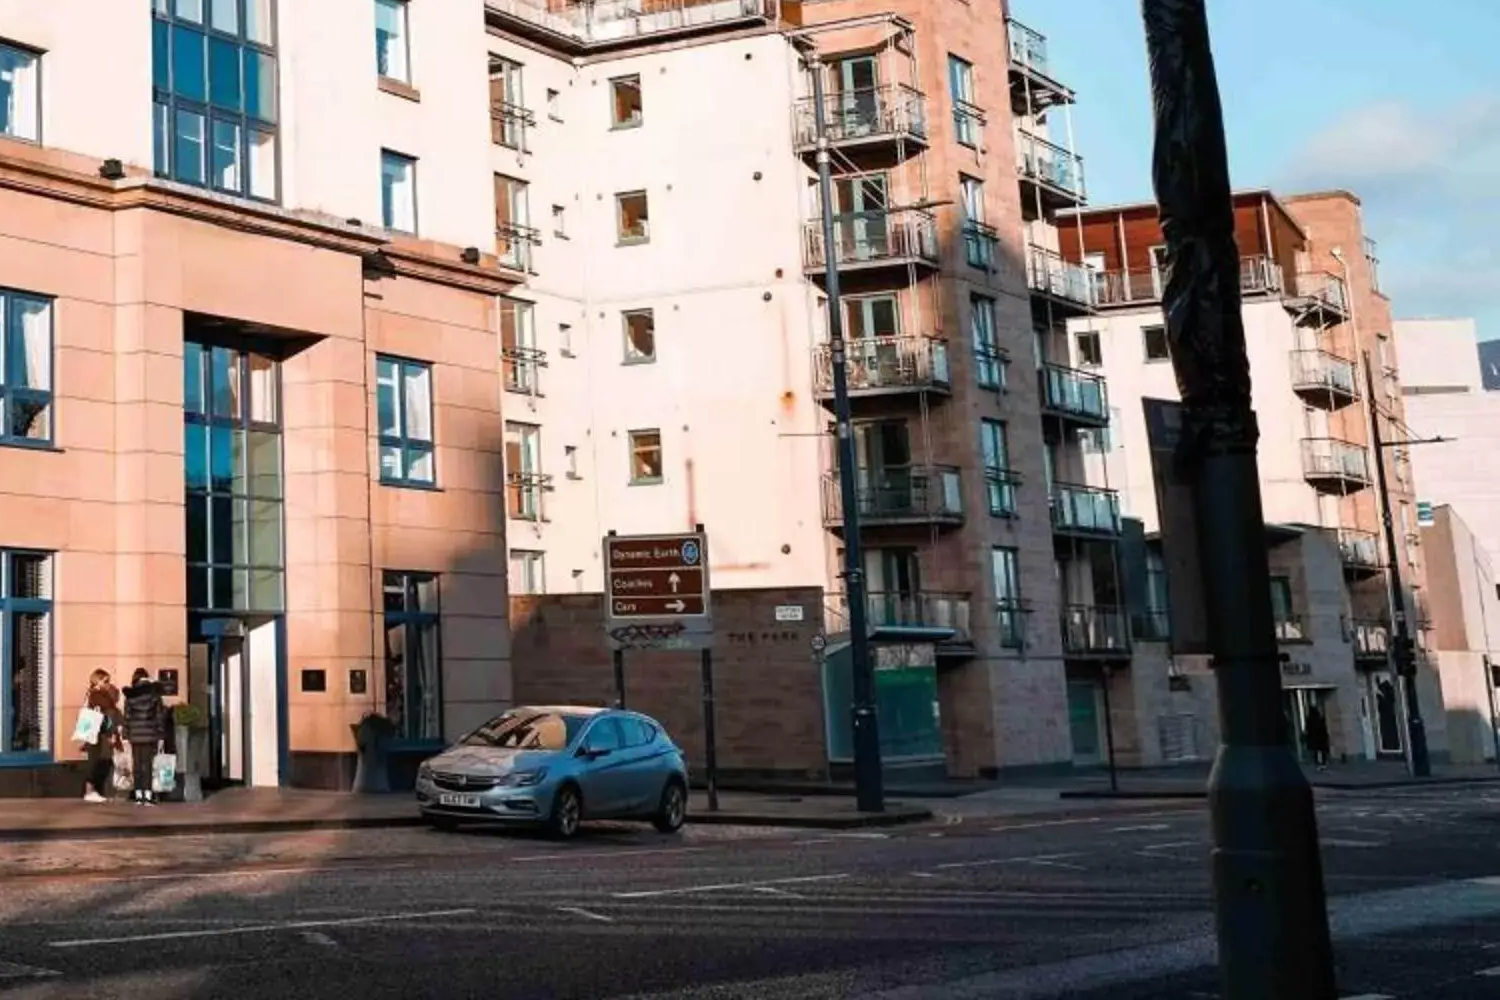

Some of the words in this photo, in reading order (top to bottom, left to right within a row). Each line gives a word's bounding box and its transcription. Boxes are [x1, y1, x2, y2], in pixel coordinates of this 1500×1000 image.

[612, 548, 652, 561] Dynamic
[653, 546, 680, 559] Earth
[614, 601, 638, 612] Cars
